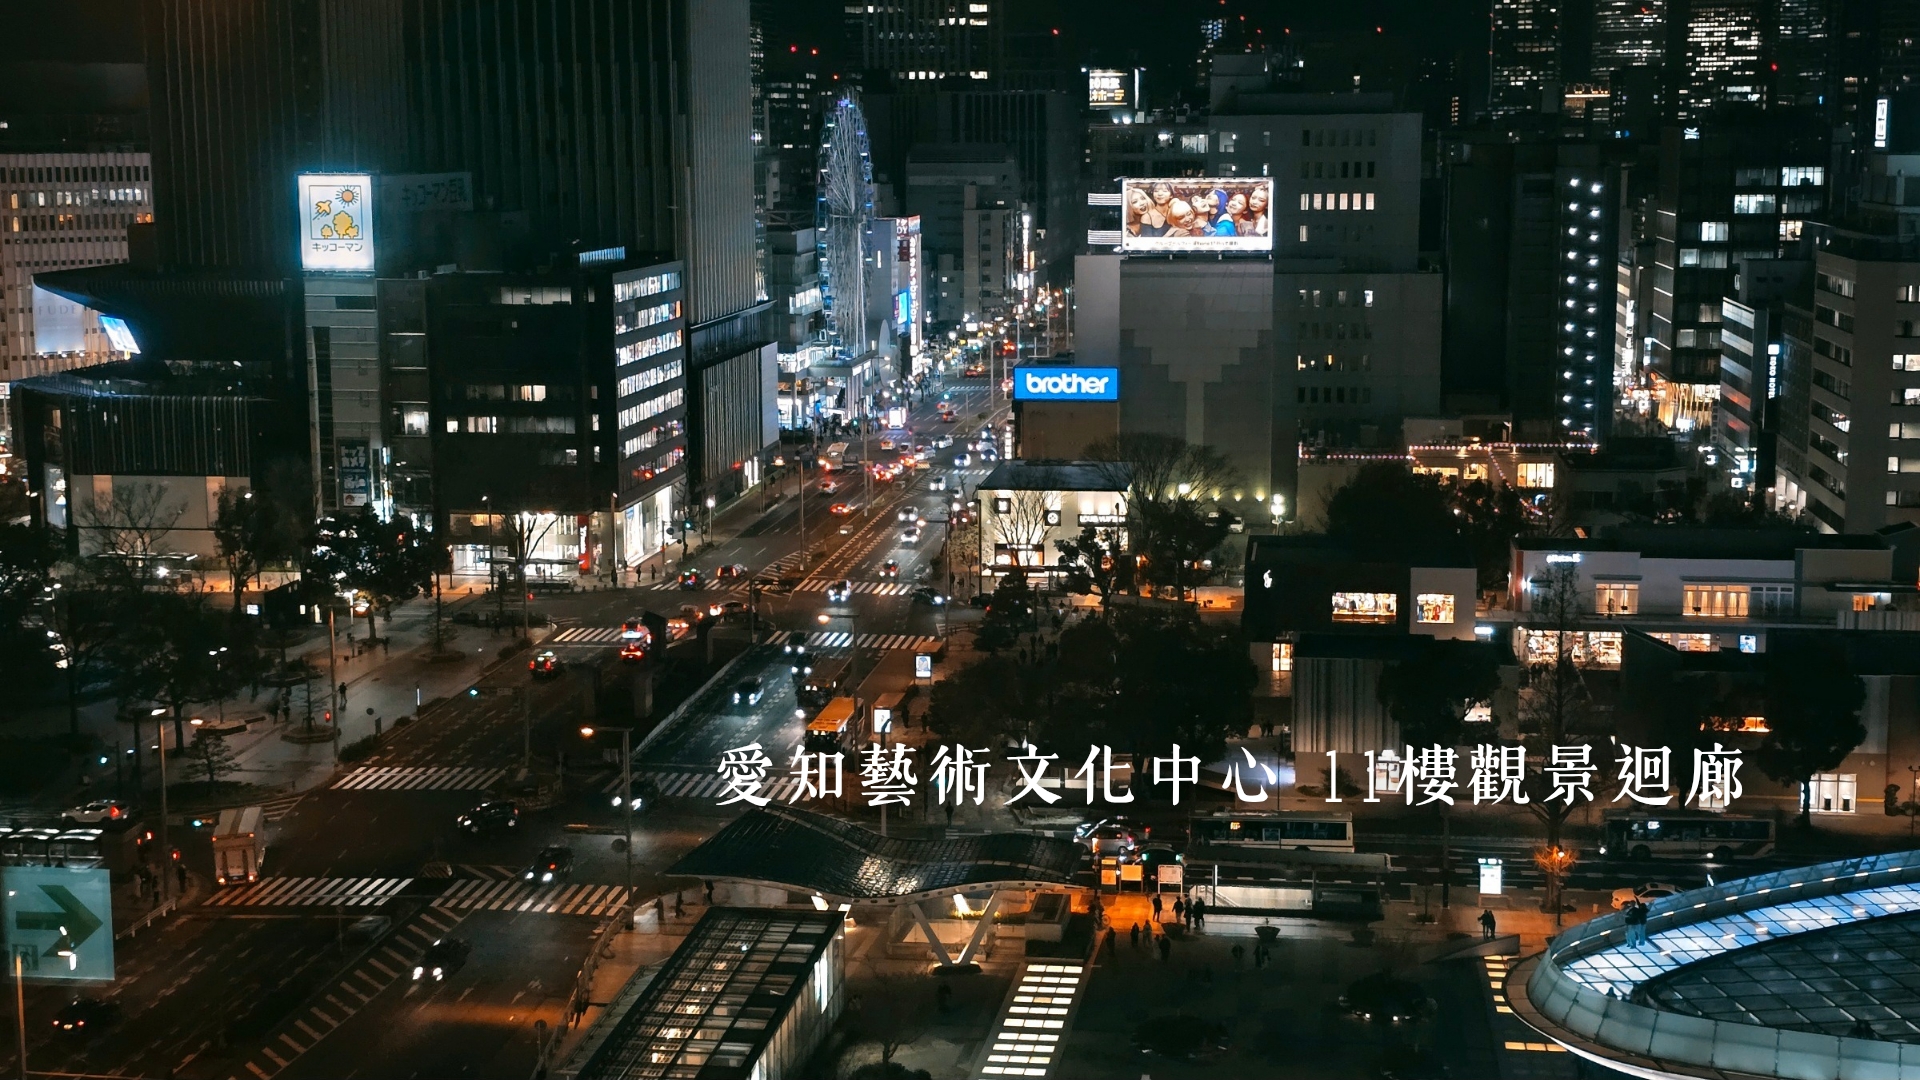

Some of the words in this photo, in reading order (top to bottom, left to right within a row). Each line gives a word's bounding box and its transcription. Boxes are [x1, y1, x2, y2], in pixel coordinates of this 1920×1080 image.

[312, 242, 363, 252] キッコーマン
[1026, 373, 1109, 393] brother
